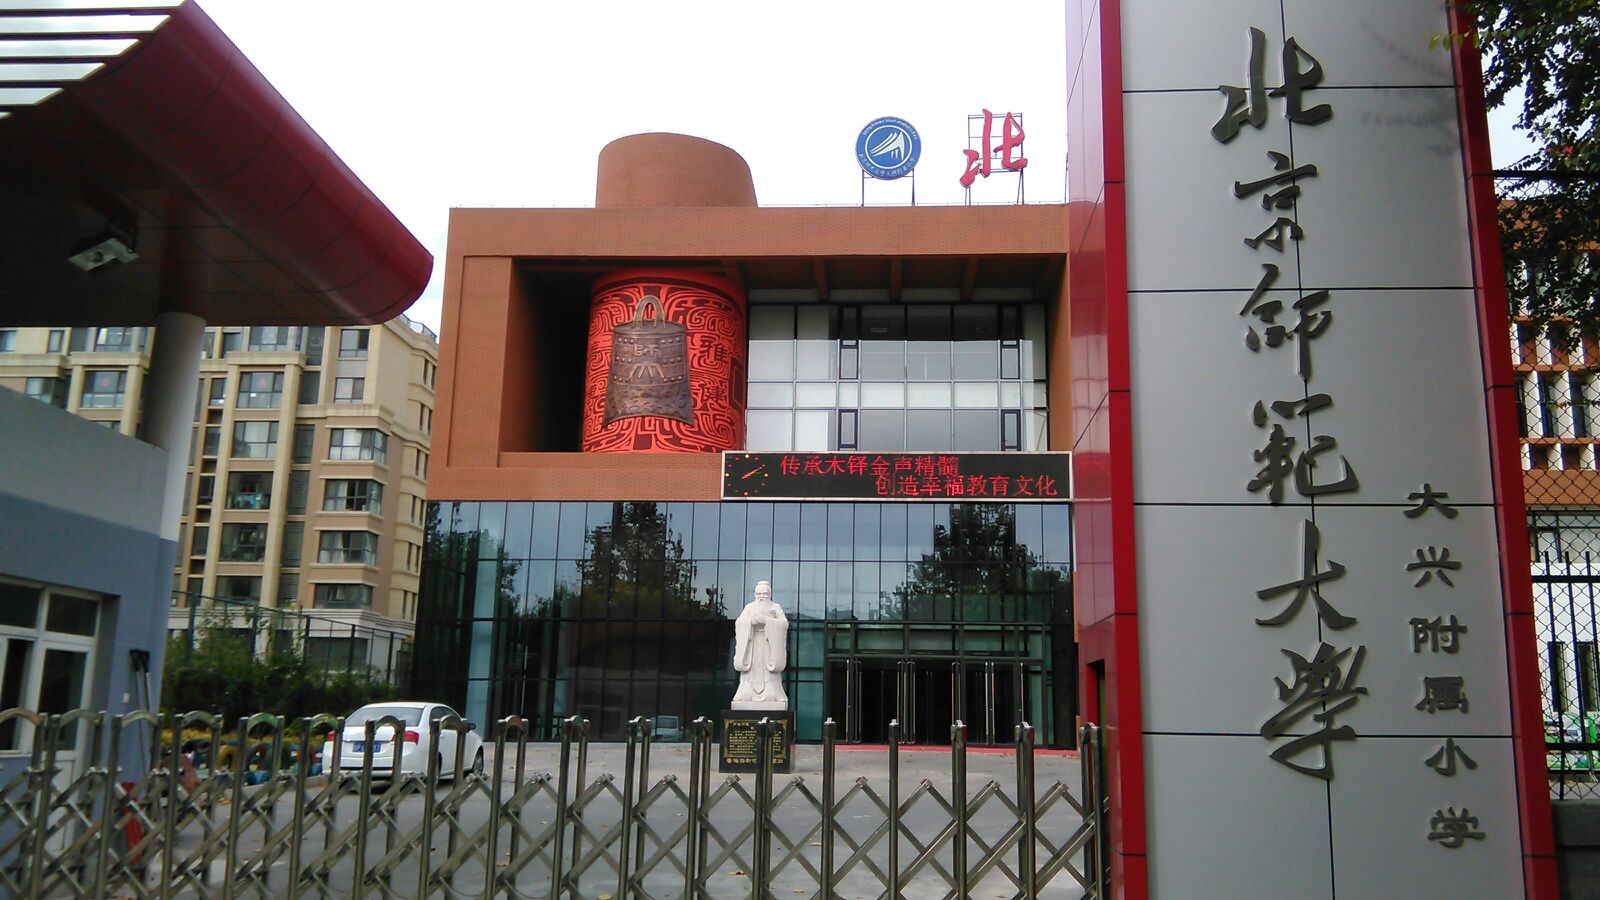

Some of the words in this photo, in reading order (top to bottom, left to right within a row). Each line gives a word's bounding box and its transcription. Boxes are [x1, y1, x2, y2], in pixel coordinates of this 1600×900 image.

[960, 108, 1028, 189] 北
[781, 455, 959, 476] 传承木铎金声精髓
[875, 474, 1058, 496] 创造幸福教育文化
[1403, 483, 1487, 848] 大兴附属小学
